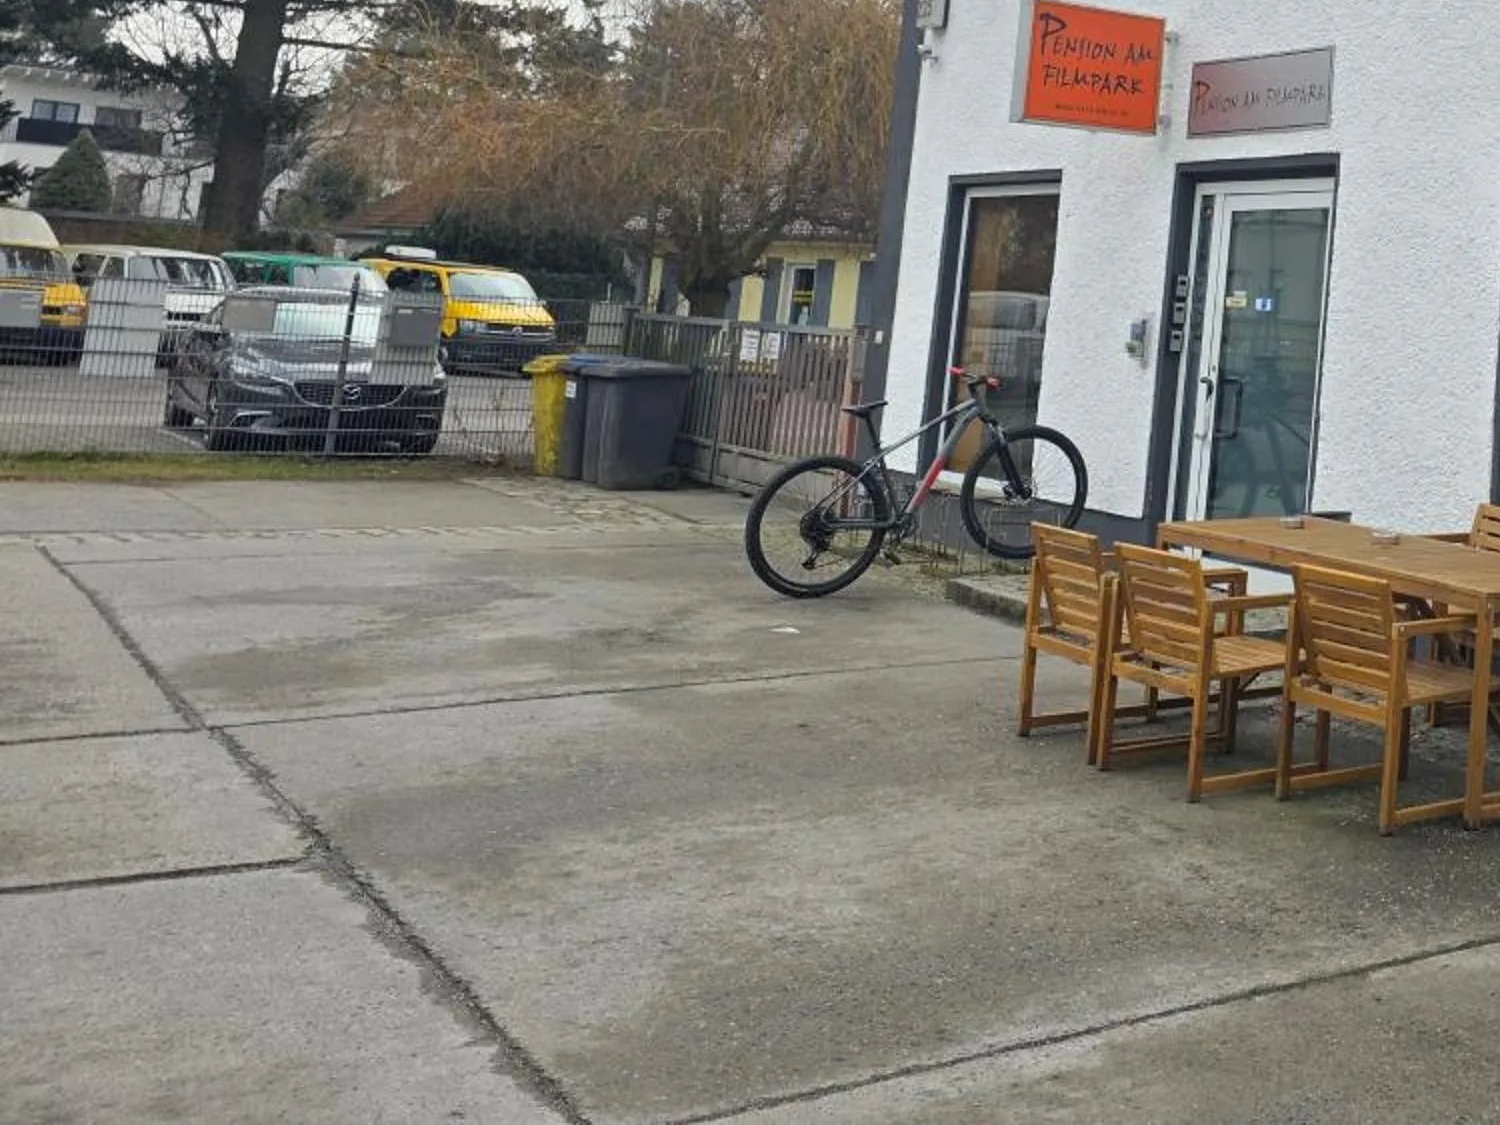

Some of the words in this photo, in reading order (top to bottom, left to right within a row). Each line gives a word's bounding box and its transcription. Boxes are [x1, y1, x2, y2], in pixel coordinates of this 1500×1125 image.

[1039, 13, 1117, 64] PENSION
[1125, 42, 1154, 64] AM
[1043, 64, 1145, 96] FILMPARK
